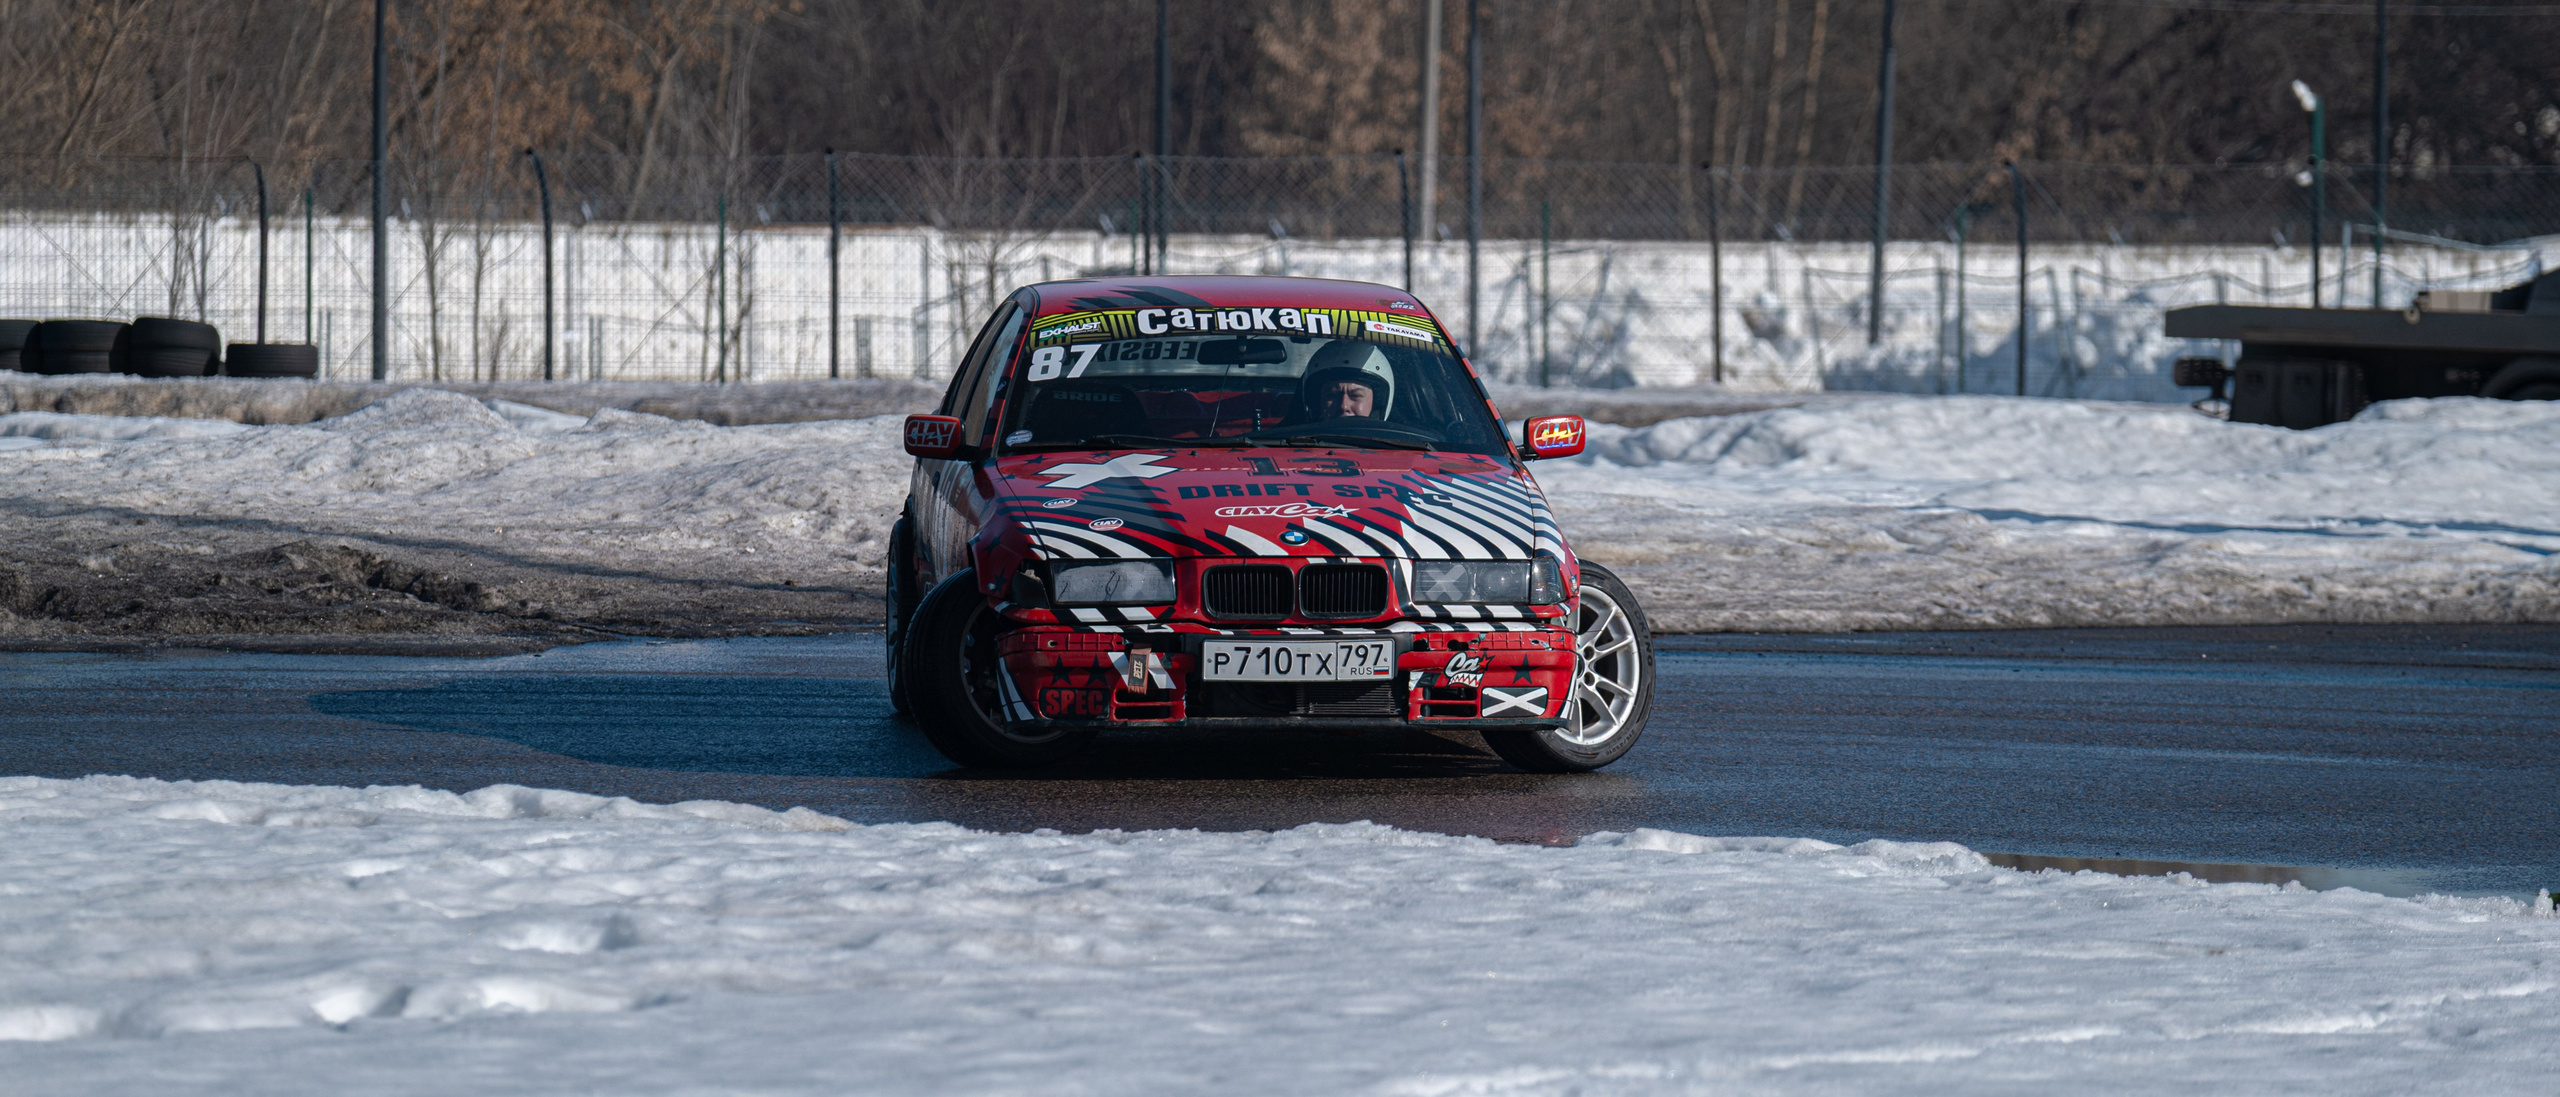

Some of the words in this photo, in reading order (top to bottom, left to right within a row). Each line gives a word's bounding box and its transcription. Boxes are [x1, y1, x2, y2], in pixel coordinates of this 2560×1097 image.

[1039, 322, 1101, 338] EXHAUST
[1027, 344, 1101, 382] 87
[1053, 390, 1122, 403] BRIDE
[1238, 456, 1365, 477] 13
[1178, 483, 1313, 500] DRIFT
[1331, 484, 1453, 507] SPEC
[1339, 644, 1384, 667] 797
[1351, 667, 1372, 676] RUS
[1045, 690, 1103, 715] SPEC
